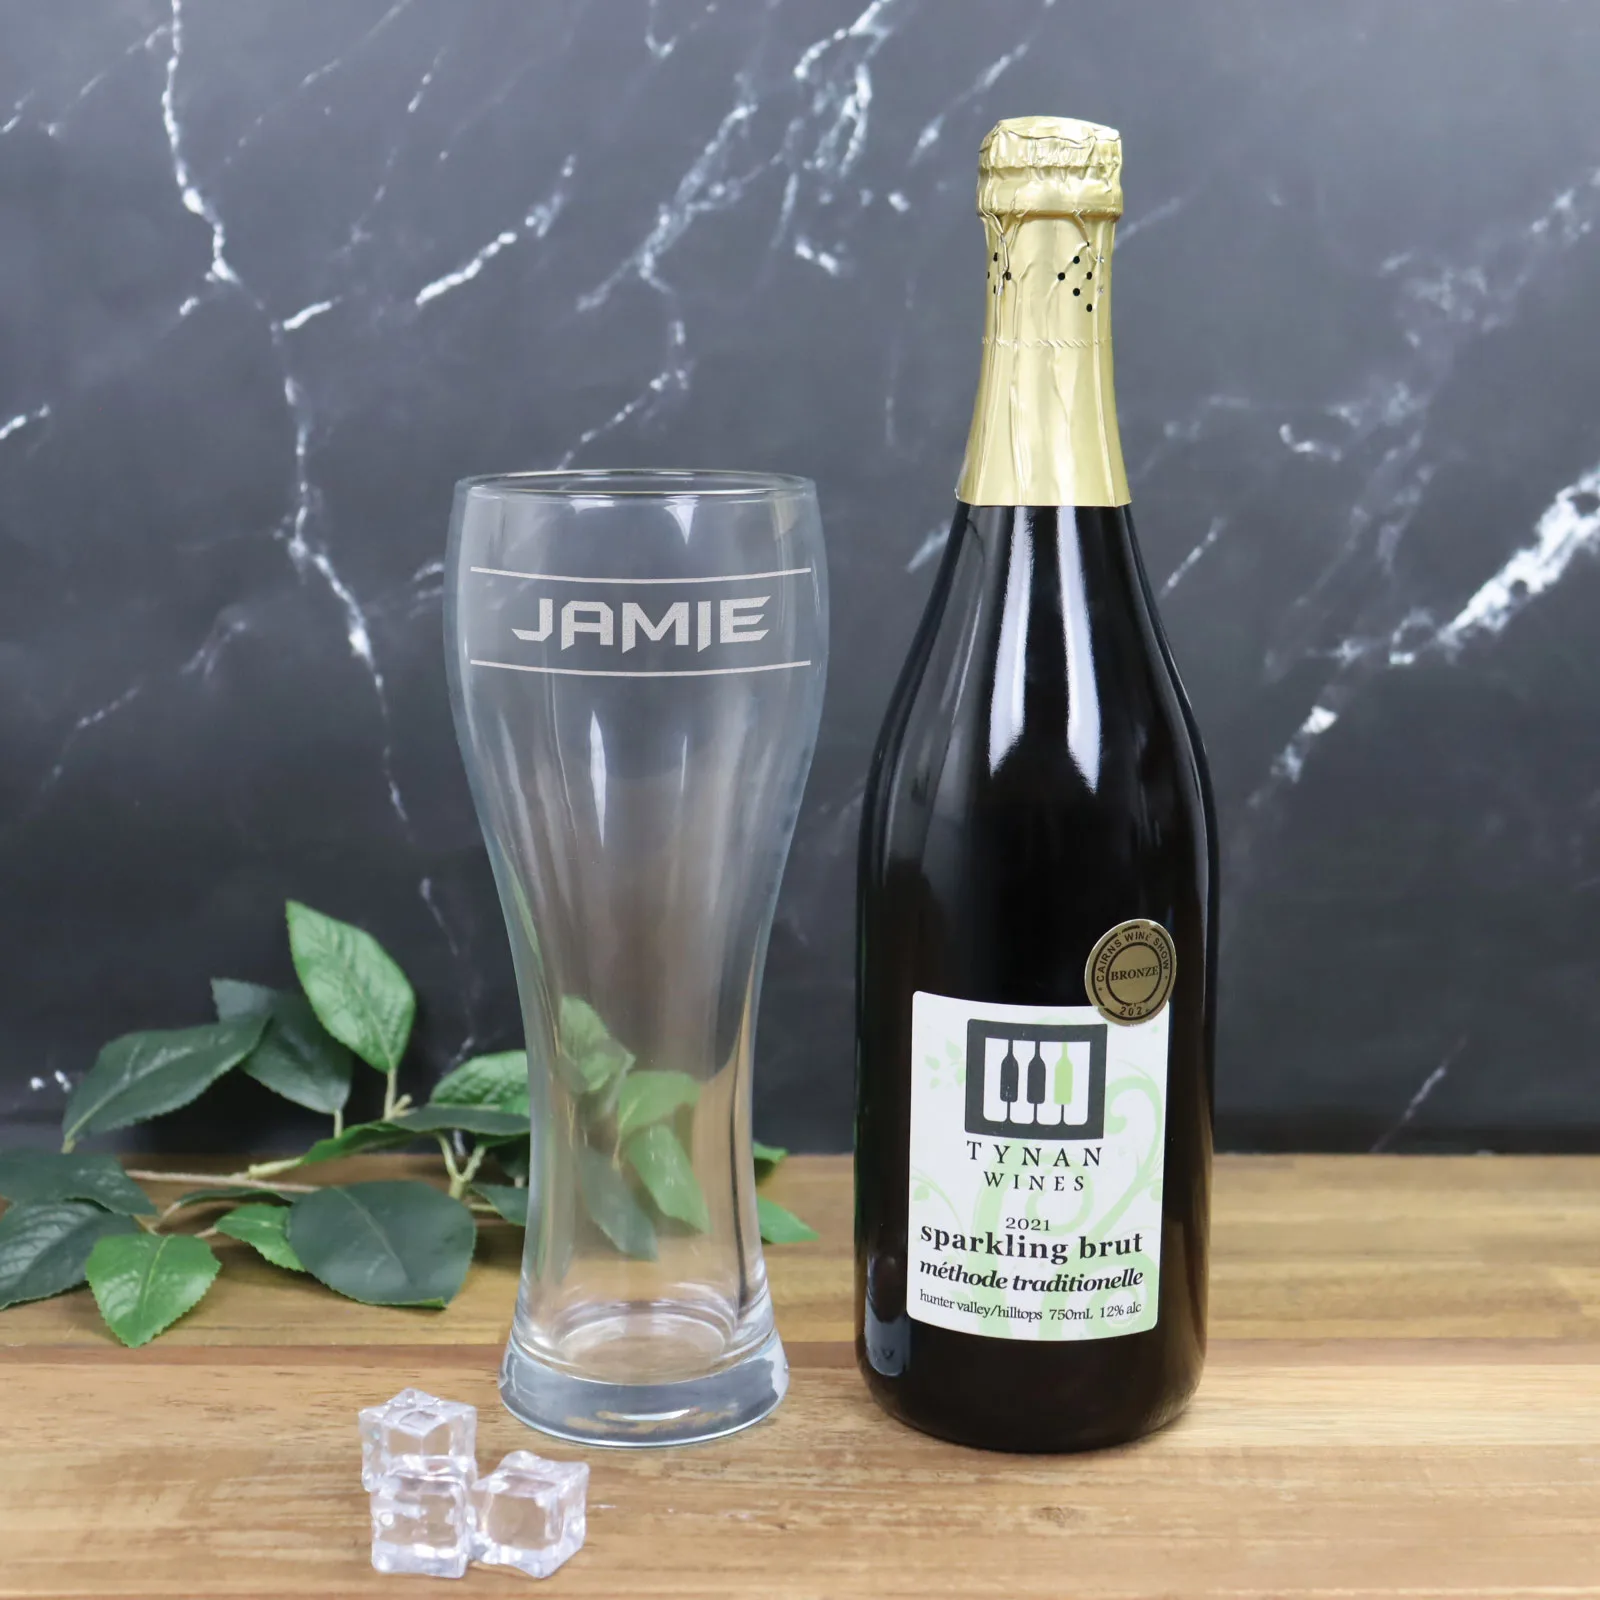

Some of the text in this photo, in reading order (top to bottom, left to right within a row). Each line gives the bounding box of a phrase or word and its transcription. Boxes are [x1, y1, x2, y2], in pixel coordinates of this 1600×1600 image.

[511, 596, 771, 653] JAMIE
[1096, 939, 1122, 983] CAIRNS
[1153, 937, 1169, 970] SHOW
[1110, 965, 1159, 981] BRONZE
[966, 1140, 1102, 1167] TYNAN
[983, 1171, 1084, 1192] WINES
[1005, 1217, 1051, 1231] 2021
[920, 1225, 1143, 1265] sparkling brut
[919, 1260, 1144, 1292] méthode traditionelle
[919, 1288, 1142, 1323] hunter valley/hilltops 750mL 12% alc
